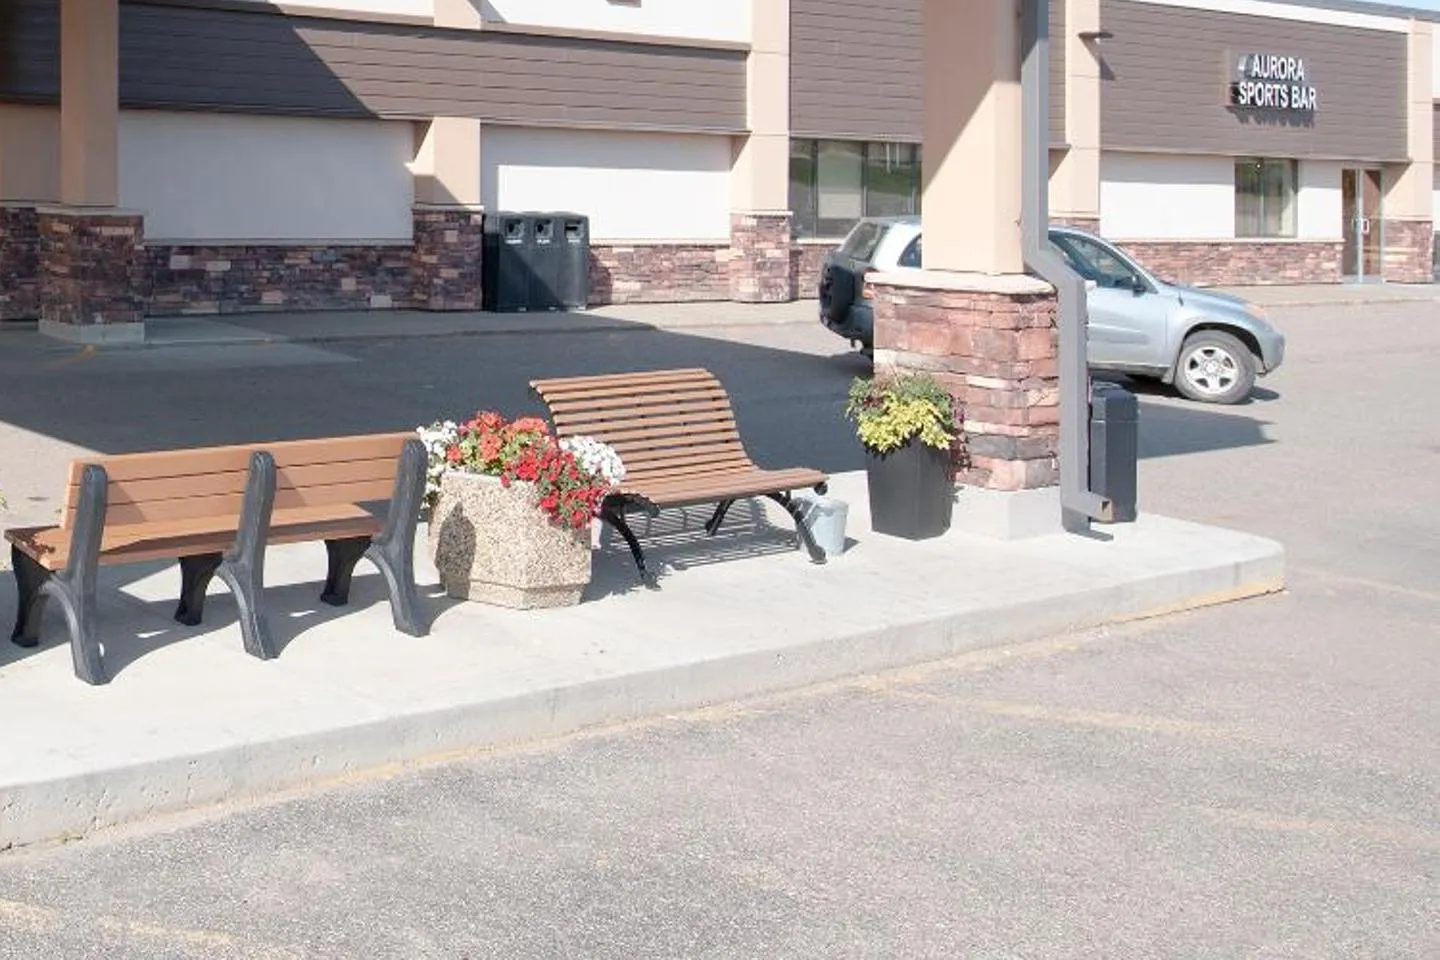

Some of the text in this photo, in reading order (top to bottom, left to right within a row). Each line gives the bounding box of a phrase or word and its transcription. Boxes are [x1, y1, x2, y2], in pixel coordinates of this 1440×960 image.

[1251, 53, 1305, 81] AURORA
[1238, 81, 1317, 110] SPORTS BAR
